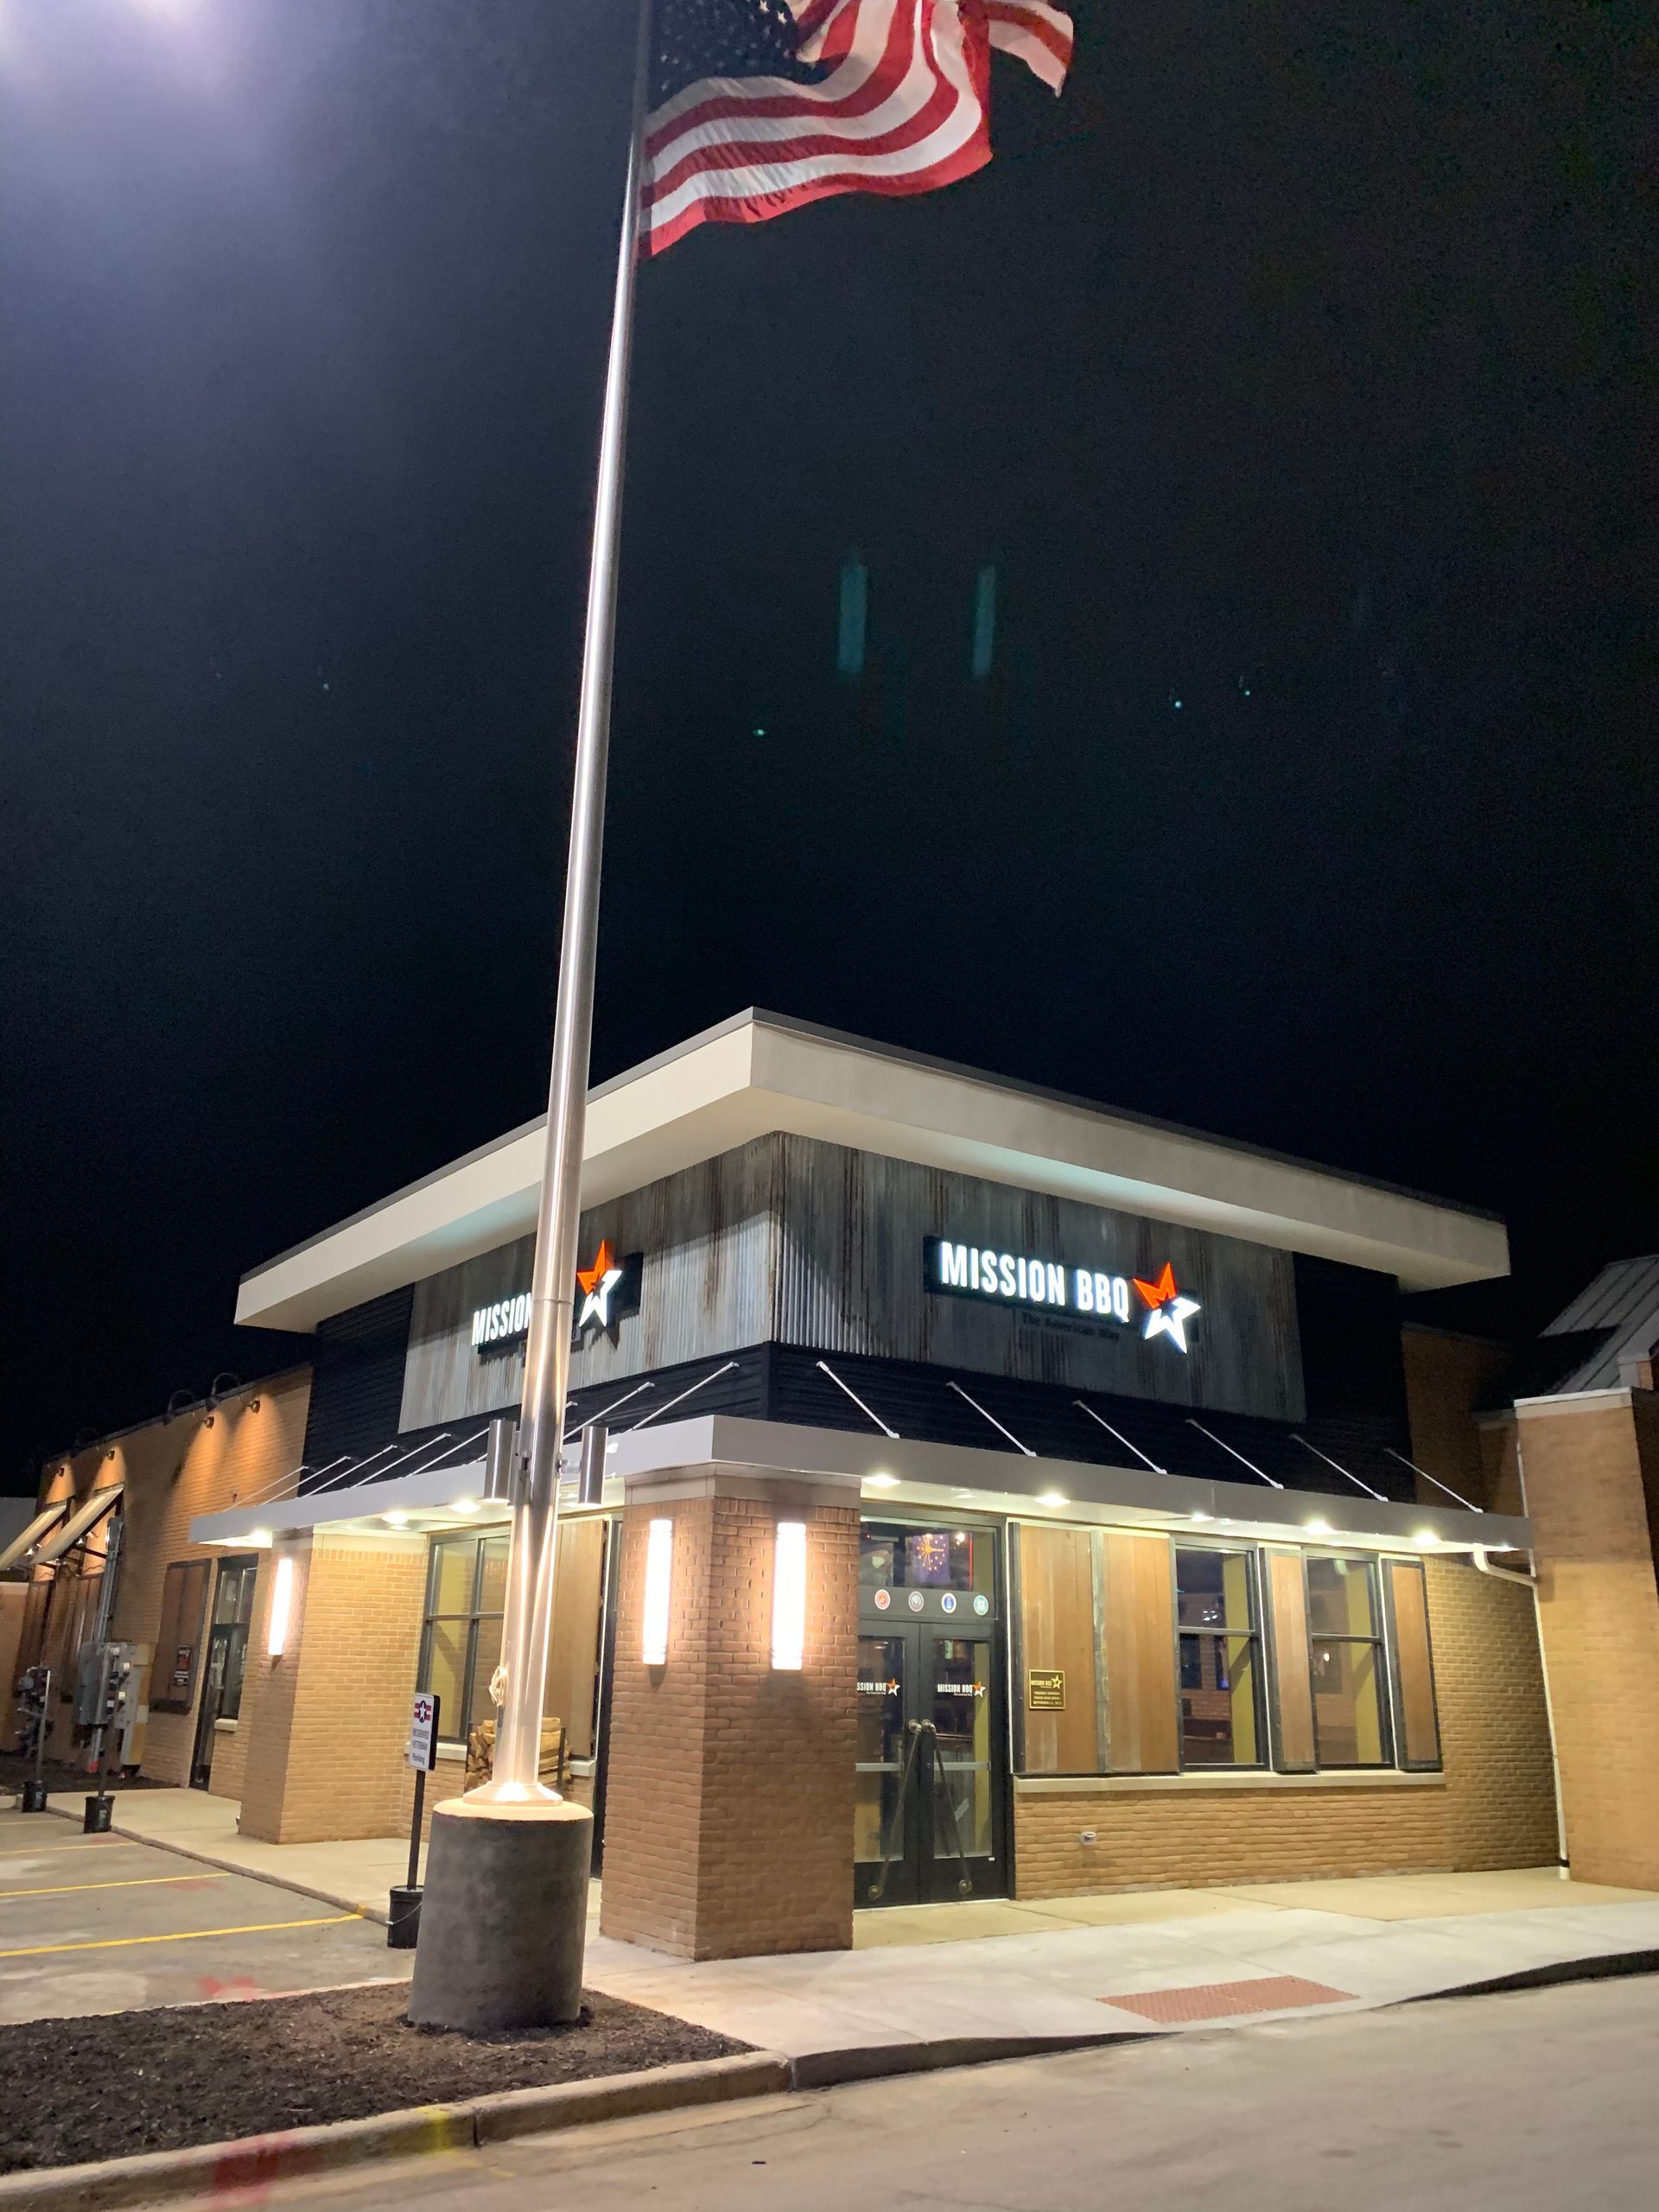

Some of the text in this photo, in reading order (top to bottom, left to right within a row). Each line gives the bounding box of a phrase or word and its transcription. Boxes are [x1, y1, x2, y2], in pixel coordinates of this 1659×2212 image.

[941, 1241, 1129, 1323] MISSION BBQ
[1022, 1312, 1040, 1326] The
[857, 1681, 874, 1692] SSION
[938, 1683, 972, 1694] MISSION BBQ
